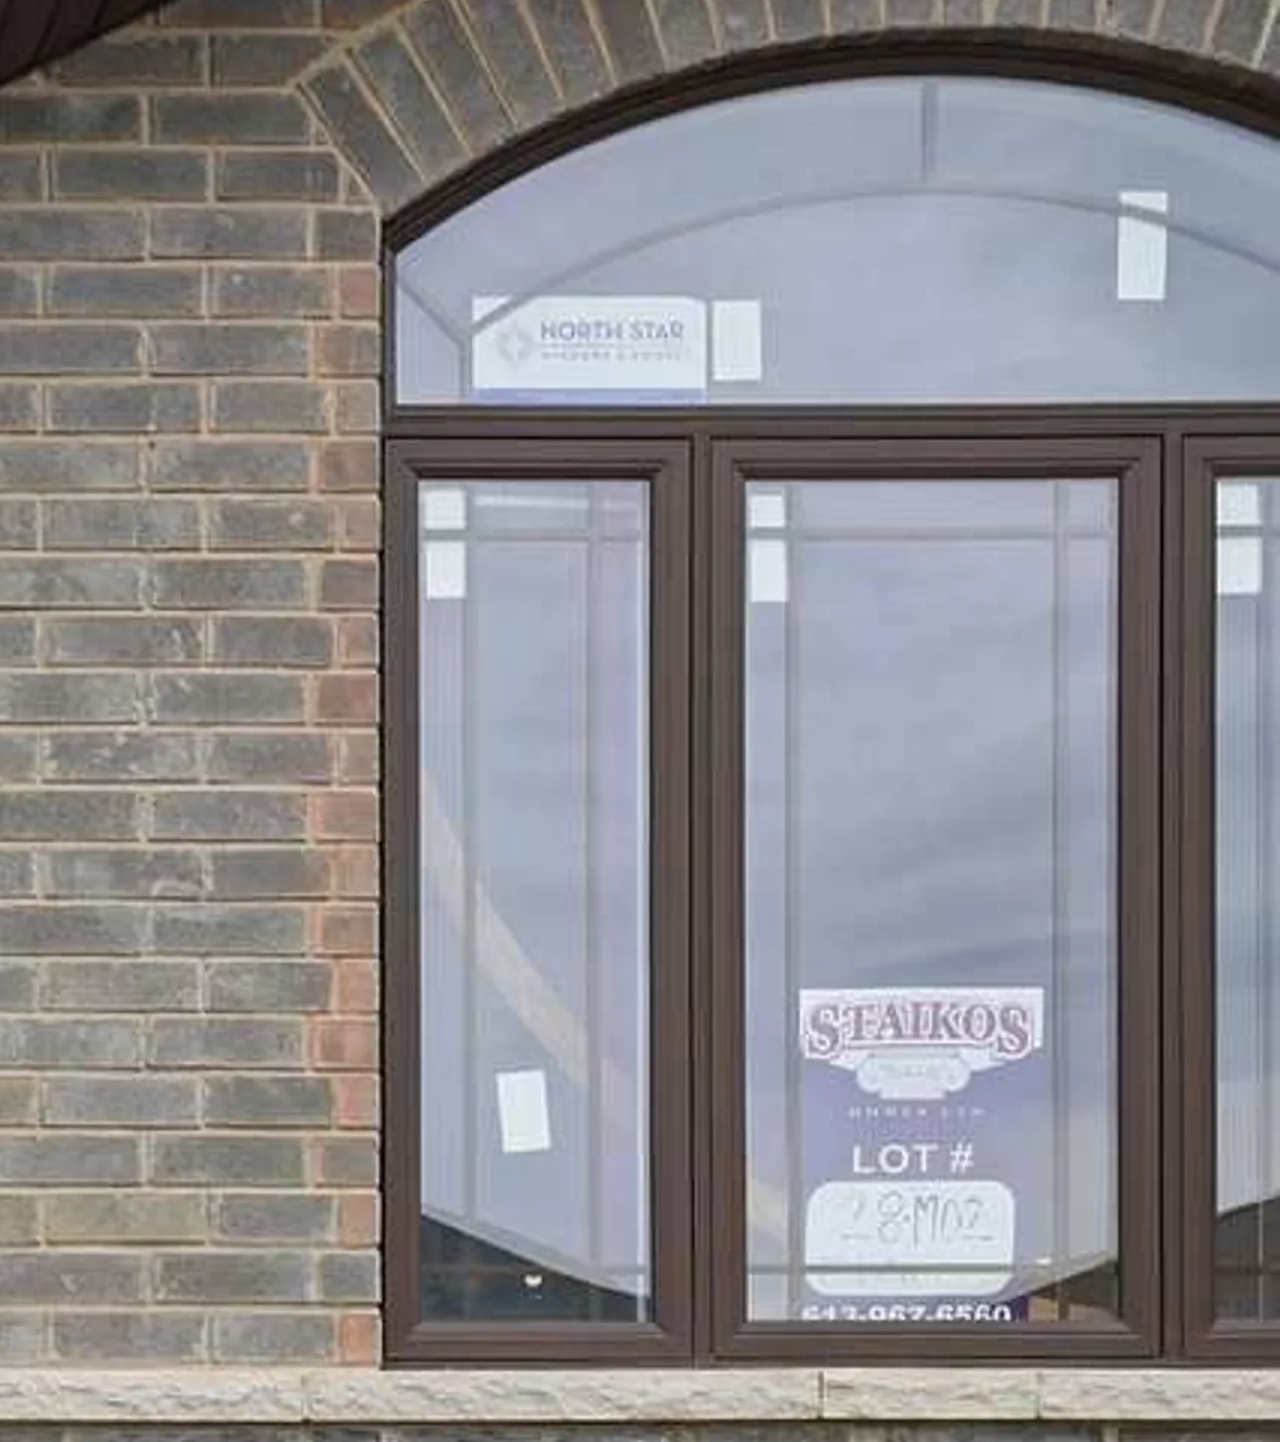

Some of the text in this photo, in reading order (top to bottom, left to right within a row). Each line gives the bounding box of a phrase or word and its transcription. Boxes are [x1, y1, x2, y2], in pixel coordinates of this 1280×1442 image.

[540, 320, 684, 340] NORTH STAR
[808, 1001, 1032, 1056] STAIKOS
[853, 1142, 975, 1174] LOT #
